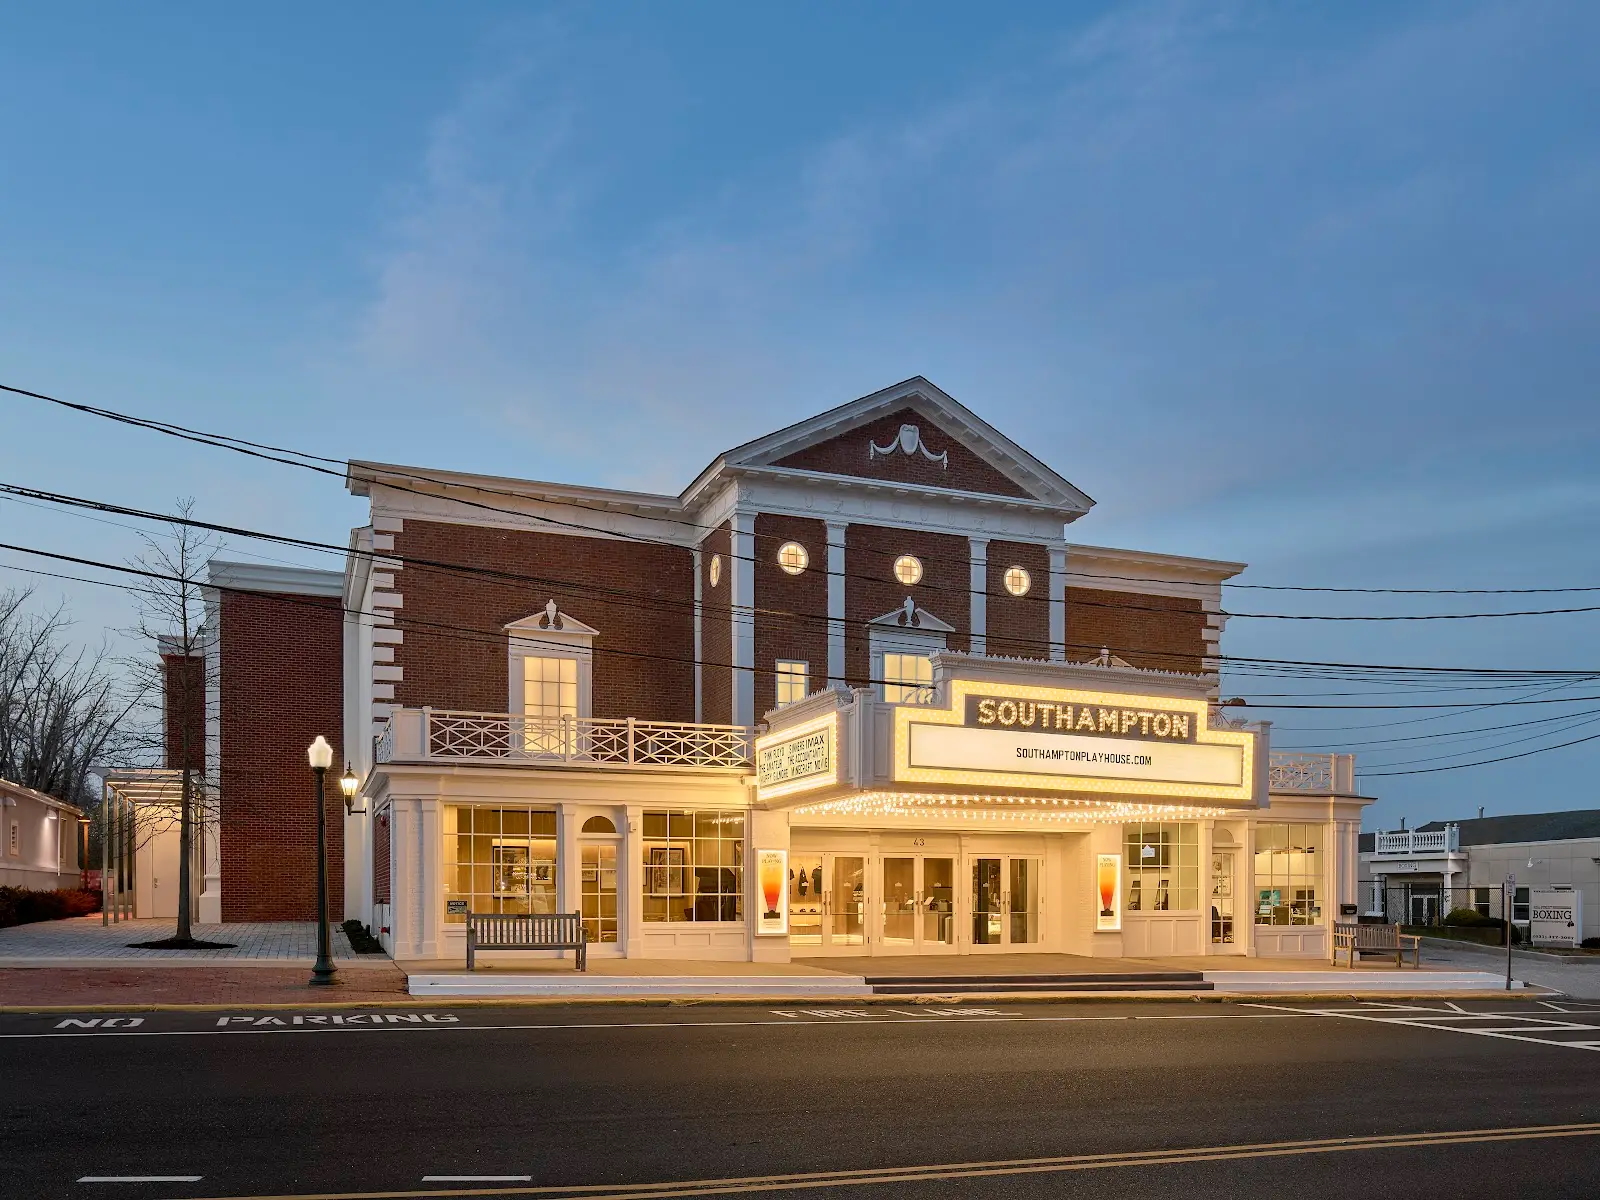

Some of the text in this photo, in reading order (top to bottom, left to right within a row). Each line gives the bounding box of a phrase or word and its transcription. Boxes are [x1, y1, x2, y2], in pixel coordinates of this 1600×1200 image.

[977, 698, 1190, 739] SOUTHAMPTON
[806, 735, 824, 748] IMAX
[1016, 747, 1152, 766] SOUTHAMPTONPLAYHOUSE.COM
[913, 837, 925, 847] 43
[1532, 909, 1572, 920] BOXING
[53, 1013, 460, 1029] NO PARKING
